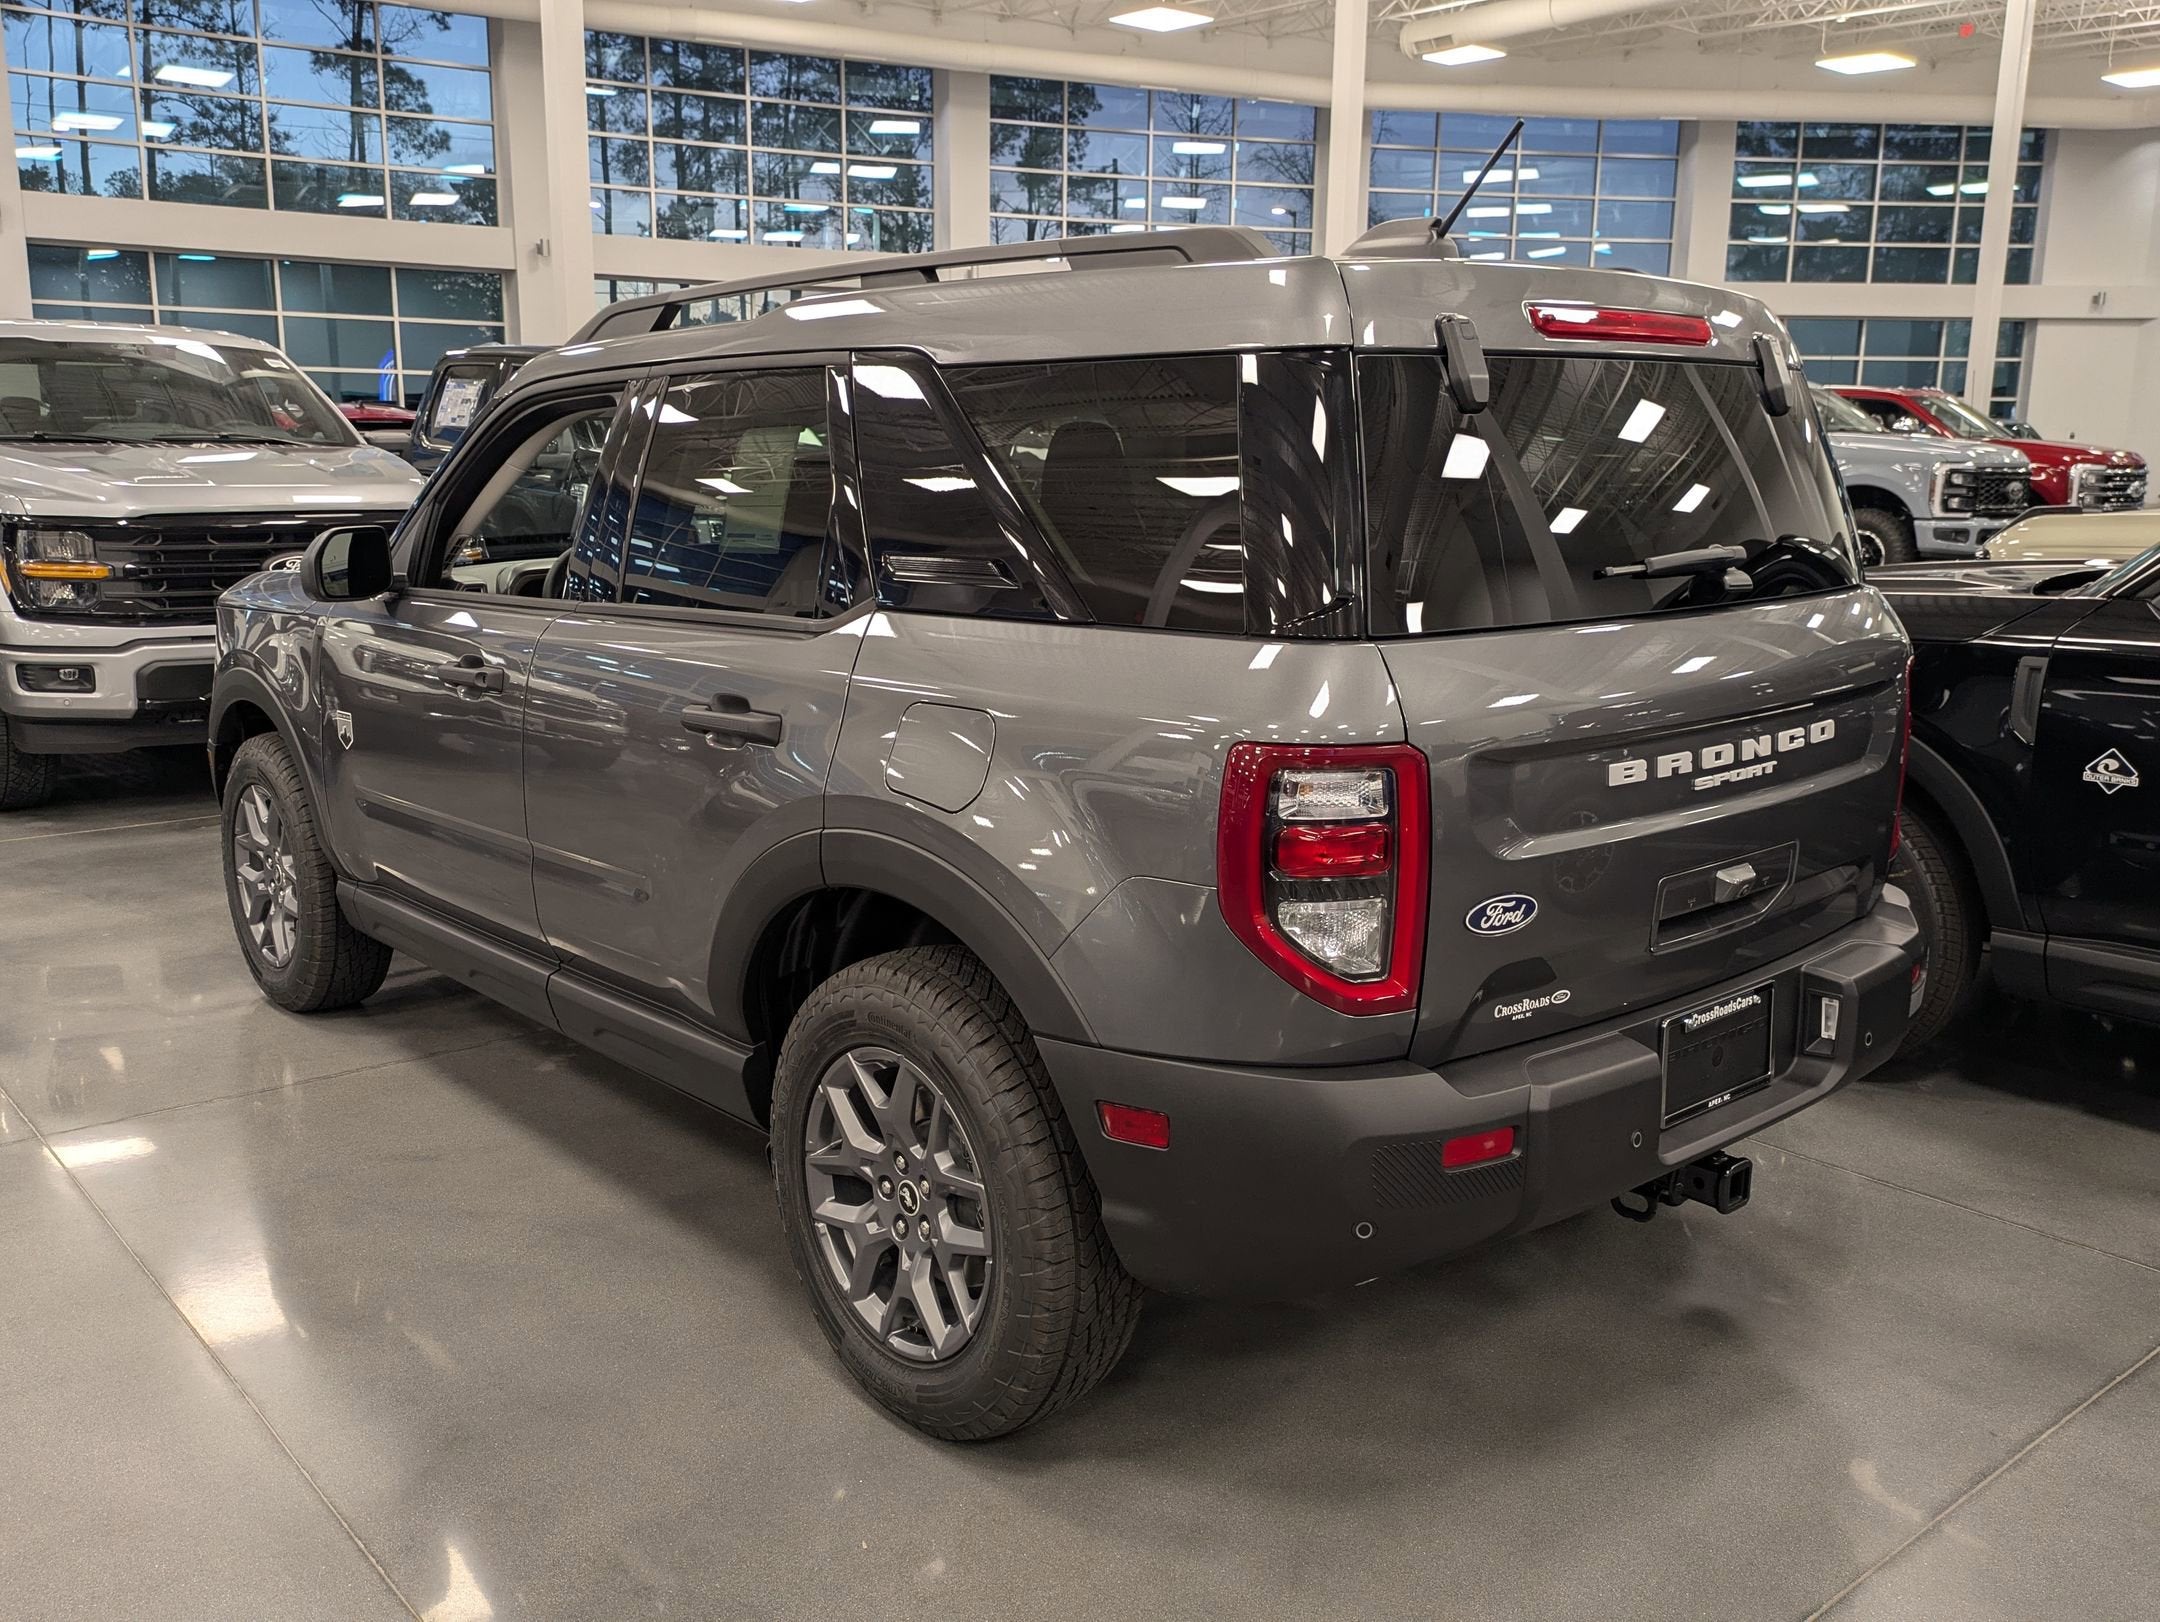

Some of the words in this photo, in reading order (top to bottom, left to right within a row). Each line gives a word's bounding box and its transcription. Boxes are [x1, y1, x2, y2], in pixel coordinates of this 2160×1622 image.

[1607, 719, 1836, 787] BRONCO
[1691, 760, 1778, 791] SPORT
[1480, 900, 1527, 929] Ford
